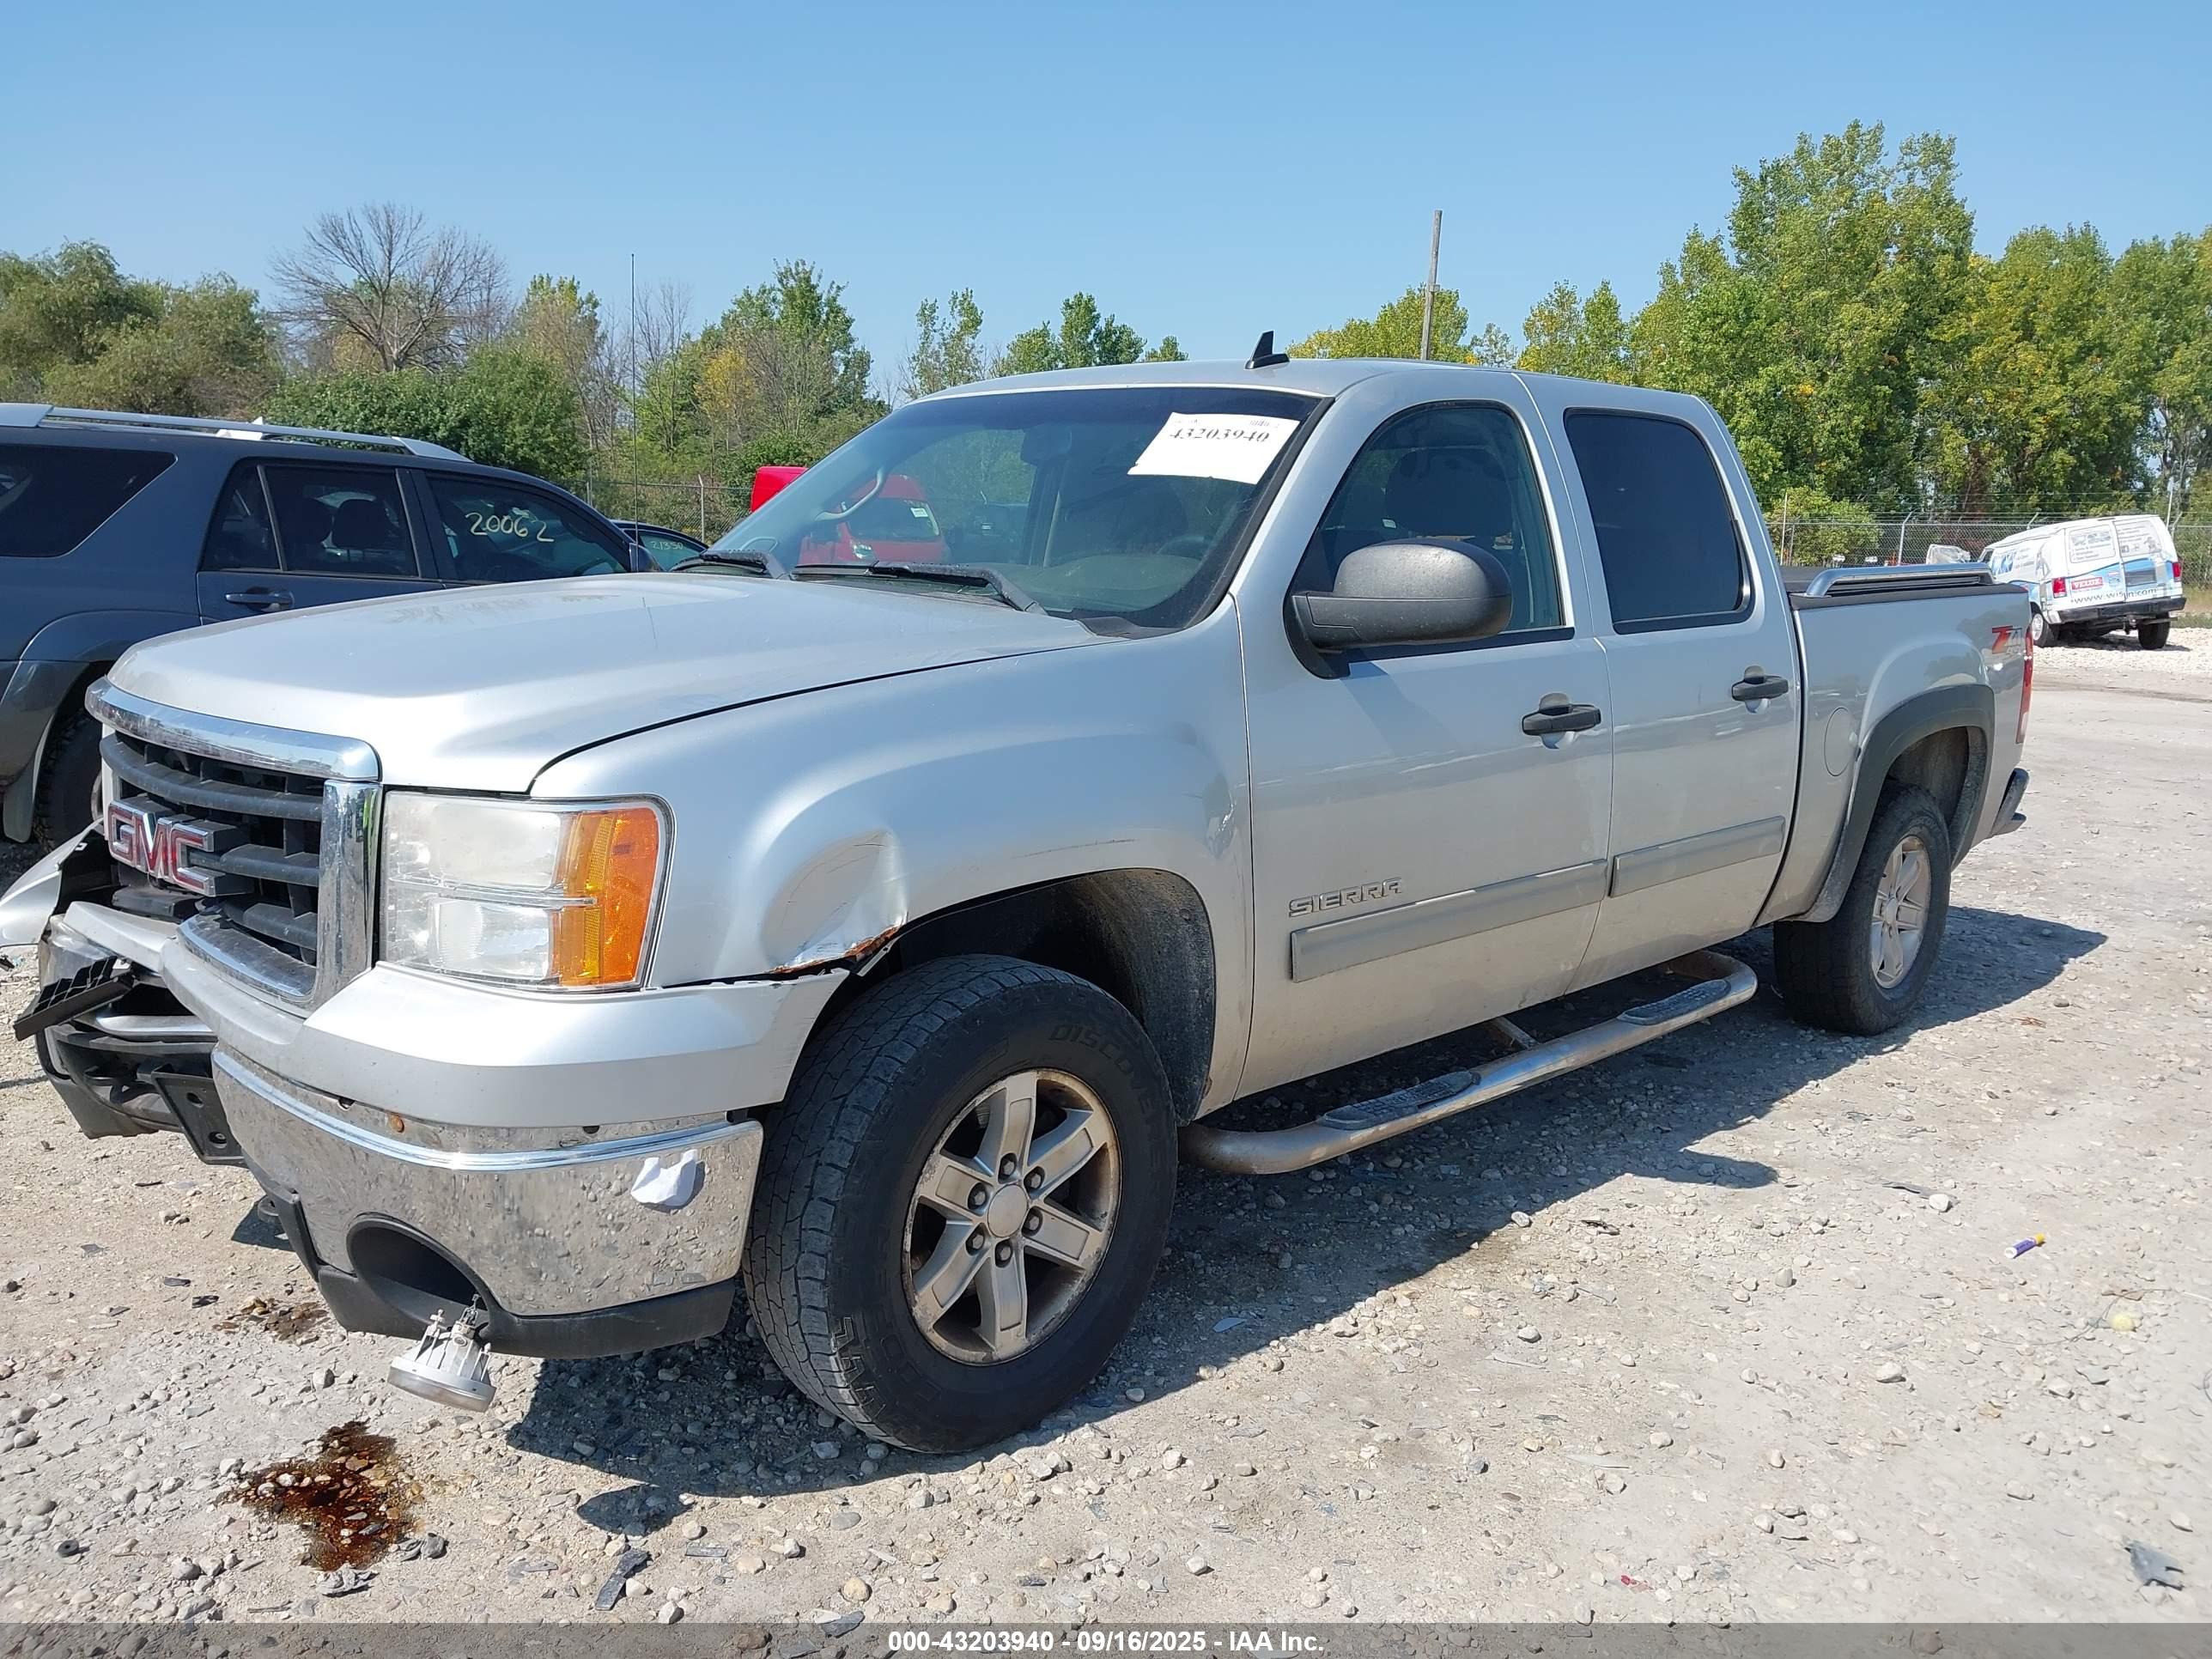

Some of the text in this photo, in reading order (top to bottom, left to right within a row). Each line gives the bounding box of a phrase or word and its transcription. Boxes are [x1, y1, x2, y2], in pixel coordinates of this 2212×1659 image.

[1170, 428, 1270, 443] 43203940
[465, 512, 555, 543] 20062
[108, 800, 215, 897] GMC
[1289, 877, 1402, 918] SIERRA
